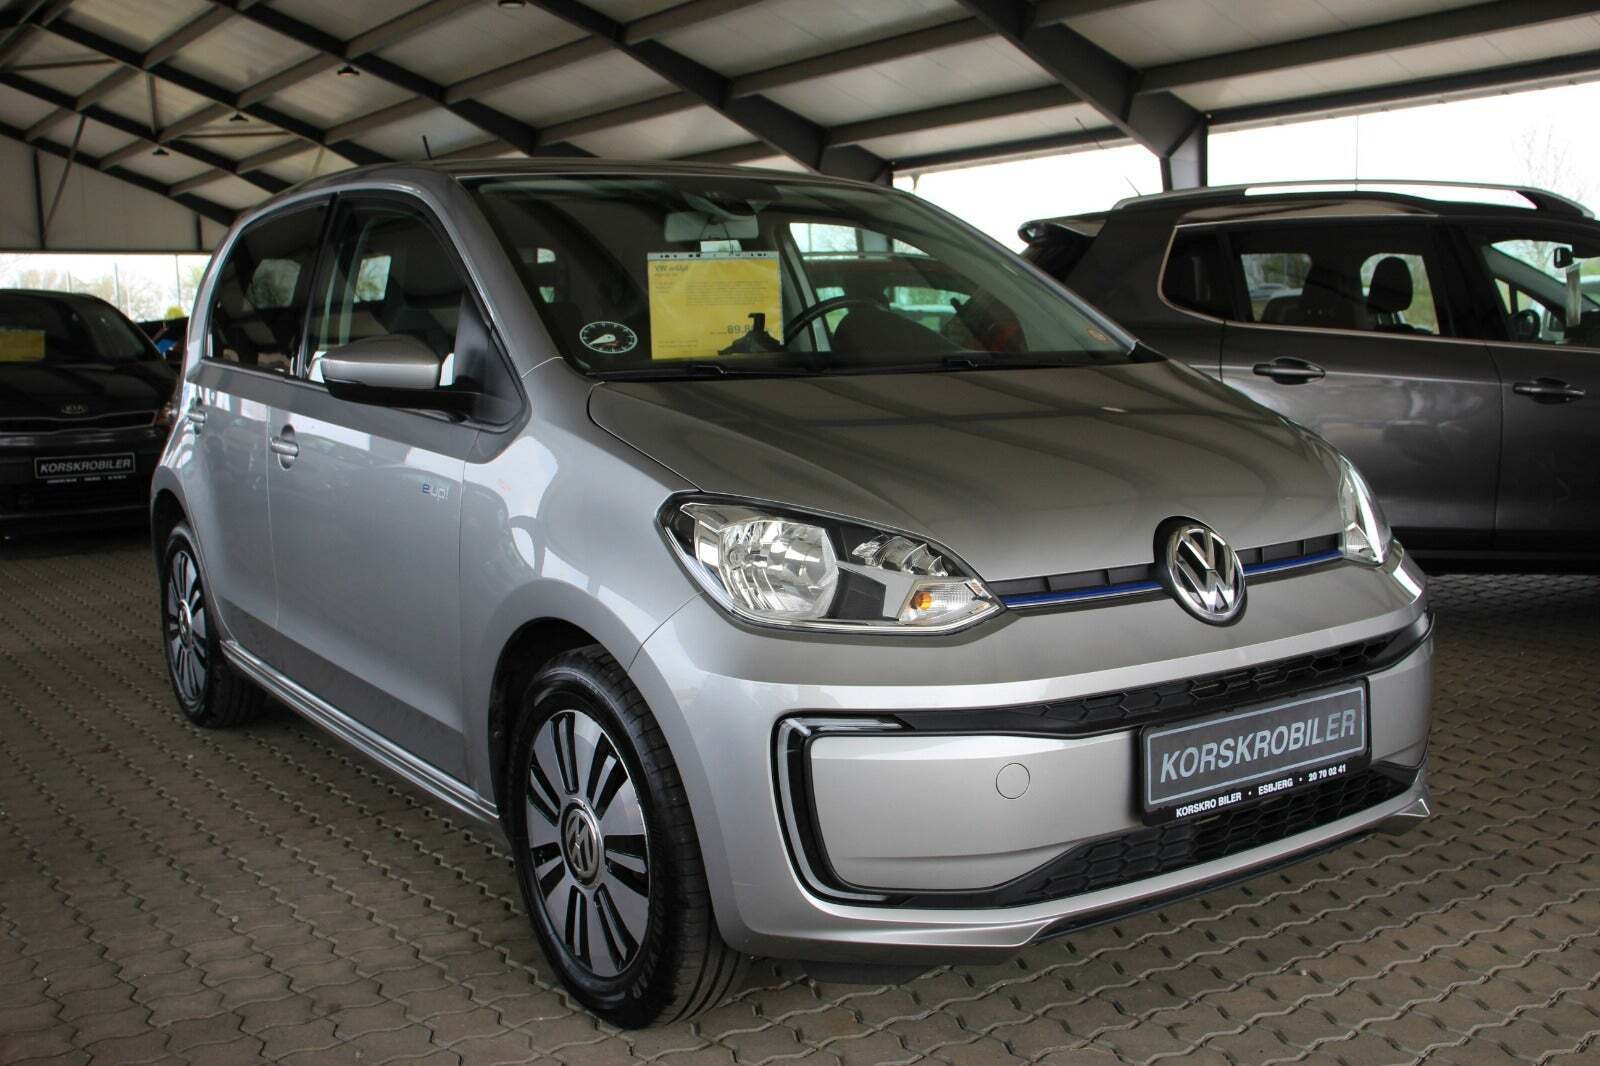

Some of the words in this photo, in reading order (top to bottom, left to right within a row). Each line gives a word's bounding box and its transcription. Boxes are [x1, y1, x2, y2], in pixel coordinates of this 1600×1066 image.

[40, 458, 131, 473] KORSKROBILER
[1160, 708, 1357, 784] KORSKROBILER
[1176, 799, 1217, 818] KORSKRO
[1218, 791, 1242, 807] BILER
[1258, 777, 1294, 796] ESBJERG
[1308, 772, 1318, 782] 20
[1318, 769, 1328, 779] 70
[1328, 766, 1338, 777] 02
[1338, 764, 1347, 774] 41
